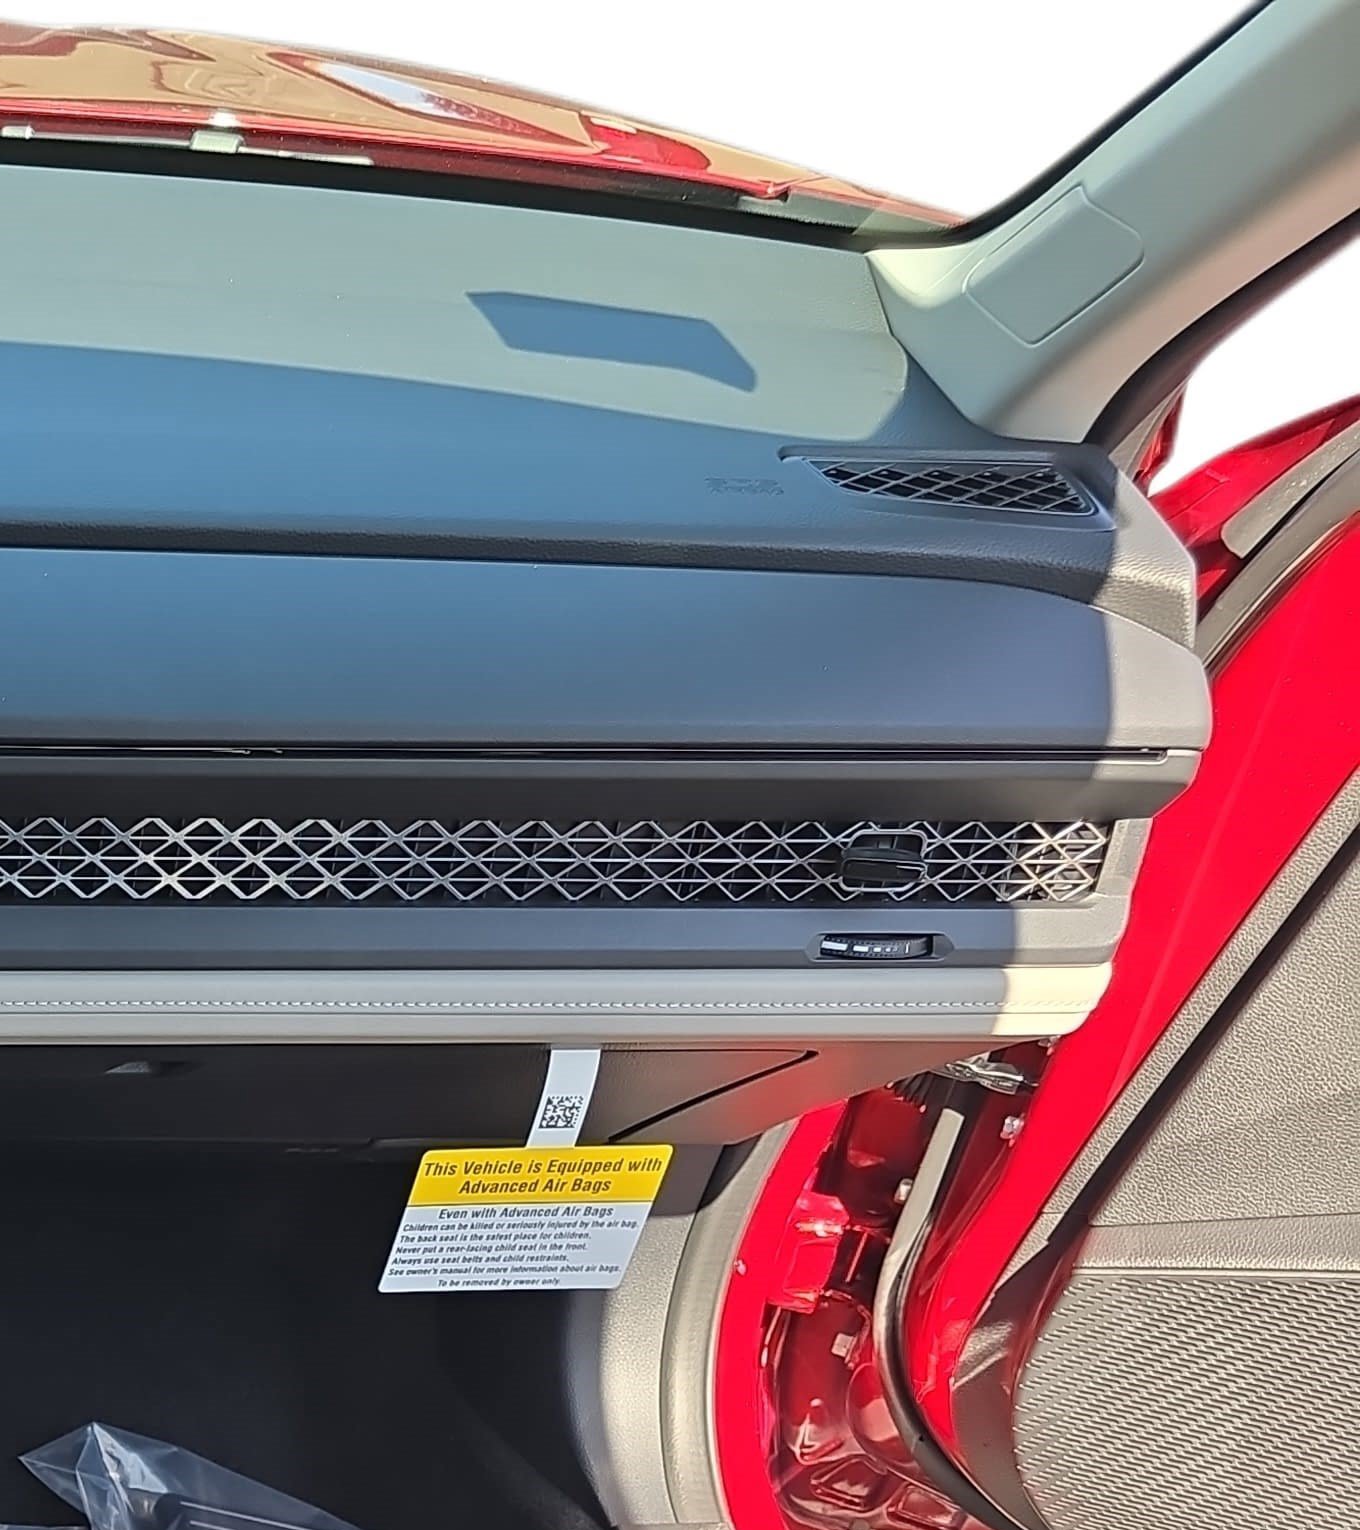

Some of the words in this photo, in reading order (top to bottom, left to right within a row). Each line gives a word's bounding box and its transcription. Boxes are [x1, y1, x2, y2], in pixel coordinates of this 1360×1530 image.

[425, 1162, 458, 1177] This
[463, 1160, 523, 1175] Vehicle
[527, 1159, 542, 1173] is
[546, 1158, 624, 1175] Equipped
[627, 1158, 662, 1172] with
[458, 1180, 540, 1195] Advanced
[542, 1178, 568, 1193] Air
[571, 1178, 612, 1194] Bags
[439, 1209, 468, 1220] Even
[471, 1208, 497, 1219] with
[499, 1206, 559, 1219] Advanced
[561, 1206, 581, 1217] Air
[583, 1206, 614, 1219] Bags
[403, 1223, 439, 1232] Children
[457, 1222, 468, 1231] be
[470, 1222, 494, 1230] killed
[506, 1221, 545, 1230] seriously
[547, 1220, 577, 1230] injured
[579, 1221, 590, 1229] by
[591, 1220, 605, 1228] the
[400, 1235, 415, 1243] The
[417, 1234, 437, 1242] back
[439, 1233, 458, 1241] seat
[460, 1233, 469, 1241] is
[470, 1233, 484, 1241] the
[513, 1232, 537, 1241] place
[539, 1232, 551, 1240] for
[396, 1246, 420, 1254] Never
[422, 1245, 437, 1255] put
[446, 1244, 493, 1253] rear-facing
[494, 1243, 517, 1251] child
[518, 1243, 537, 1251] seat
[539, 1243, 548, 1251] in
[392, 1257, 421, 1266] Always
[423, 1257, 440, 1265] use
[441, 1256, 460, 1264] seat
[462, 1255, 484, 1264] belts
[484, 1255, 501, 1263] and
[502, 1254, 525, 1263] child
[388, 1268, 404, 1276] See
[405, 1267, 438, 1275] owner's
[439, 1266, 472, 1274] manual
[510, 1265, 558, 1273] information
[559, 1264, 584, 1273] about
[584, 1264, 597, 1272] air
[438, 1279, 448, 1287] To
[448, 1279, 460, 1287] be
[499, 1278, 511, 1287] by
